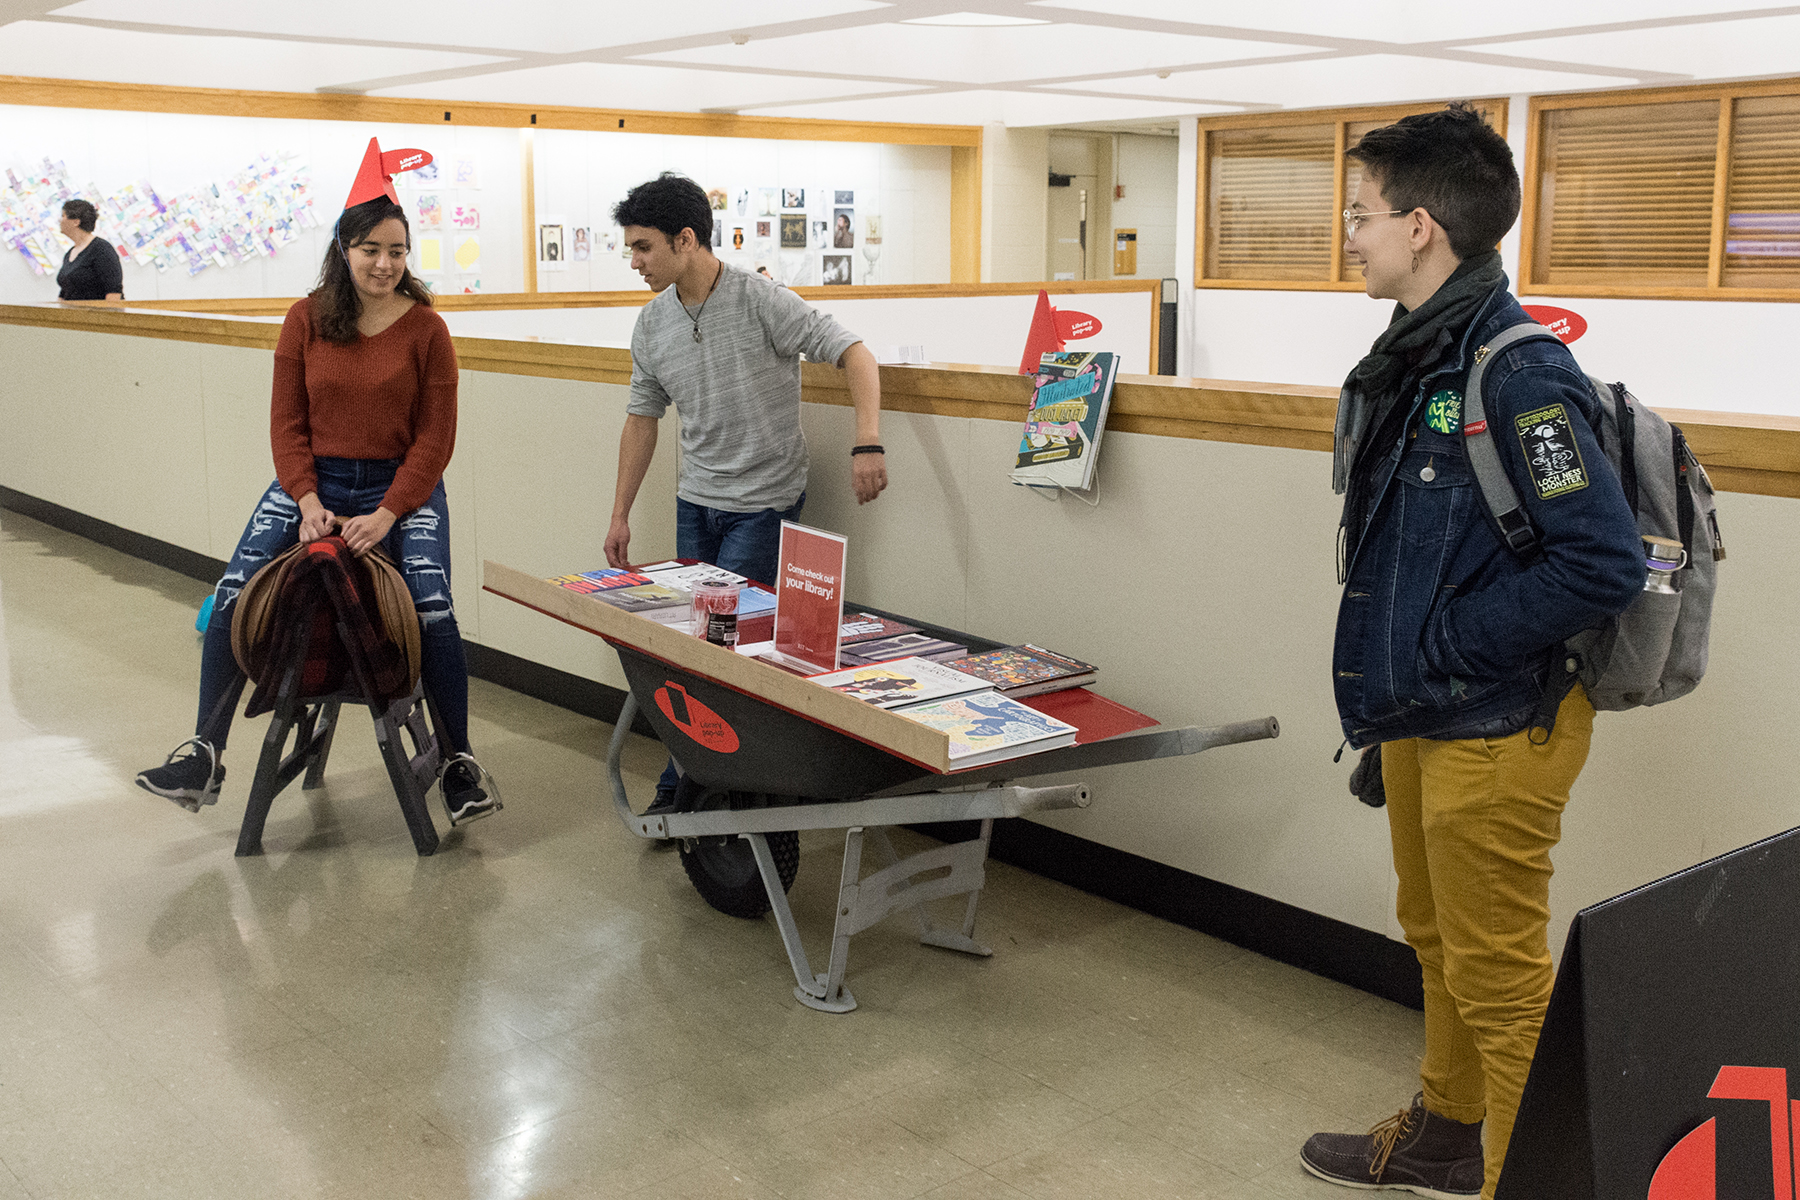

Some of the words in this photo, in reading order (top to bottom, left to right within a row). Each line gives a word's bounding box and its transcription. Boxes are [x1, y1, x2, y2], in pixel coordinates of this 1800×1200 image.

[1071, 320, 1092, 330] Library
[1072, 325, 1093, 336] pop-up
[1537, 474, 1560, 487] LOCH
[1562, 468, 1582, 480] NESS
[1542, 475, 1583, 492] MONSTER
[787, 563, 805, 576] Come
[805, 569, 823, 582] check
[824, 575, 834, 585] out
[785, 577, 804, 590] your
[804, 580, 834, 600] library!
[700, 721, 722, 730] Library
[702, 730, 725, 738] pop-up
